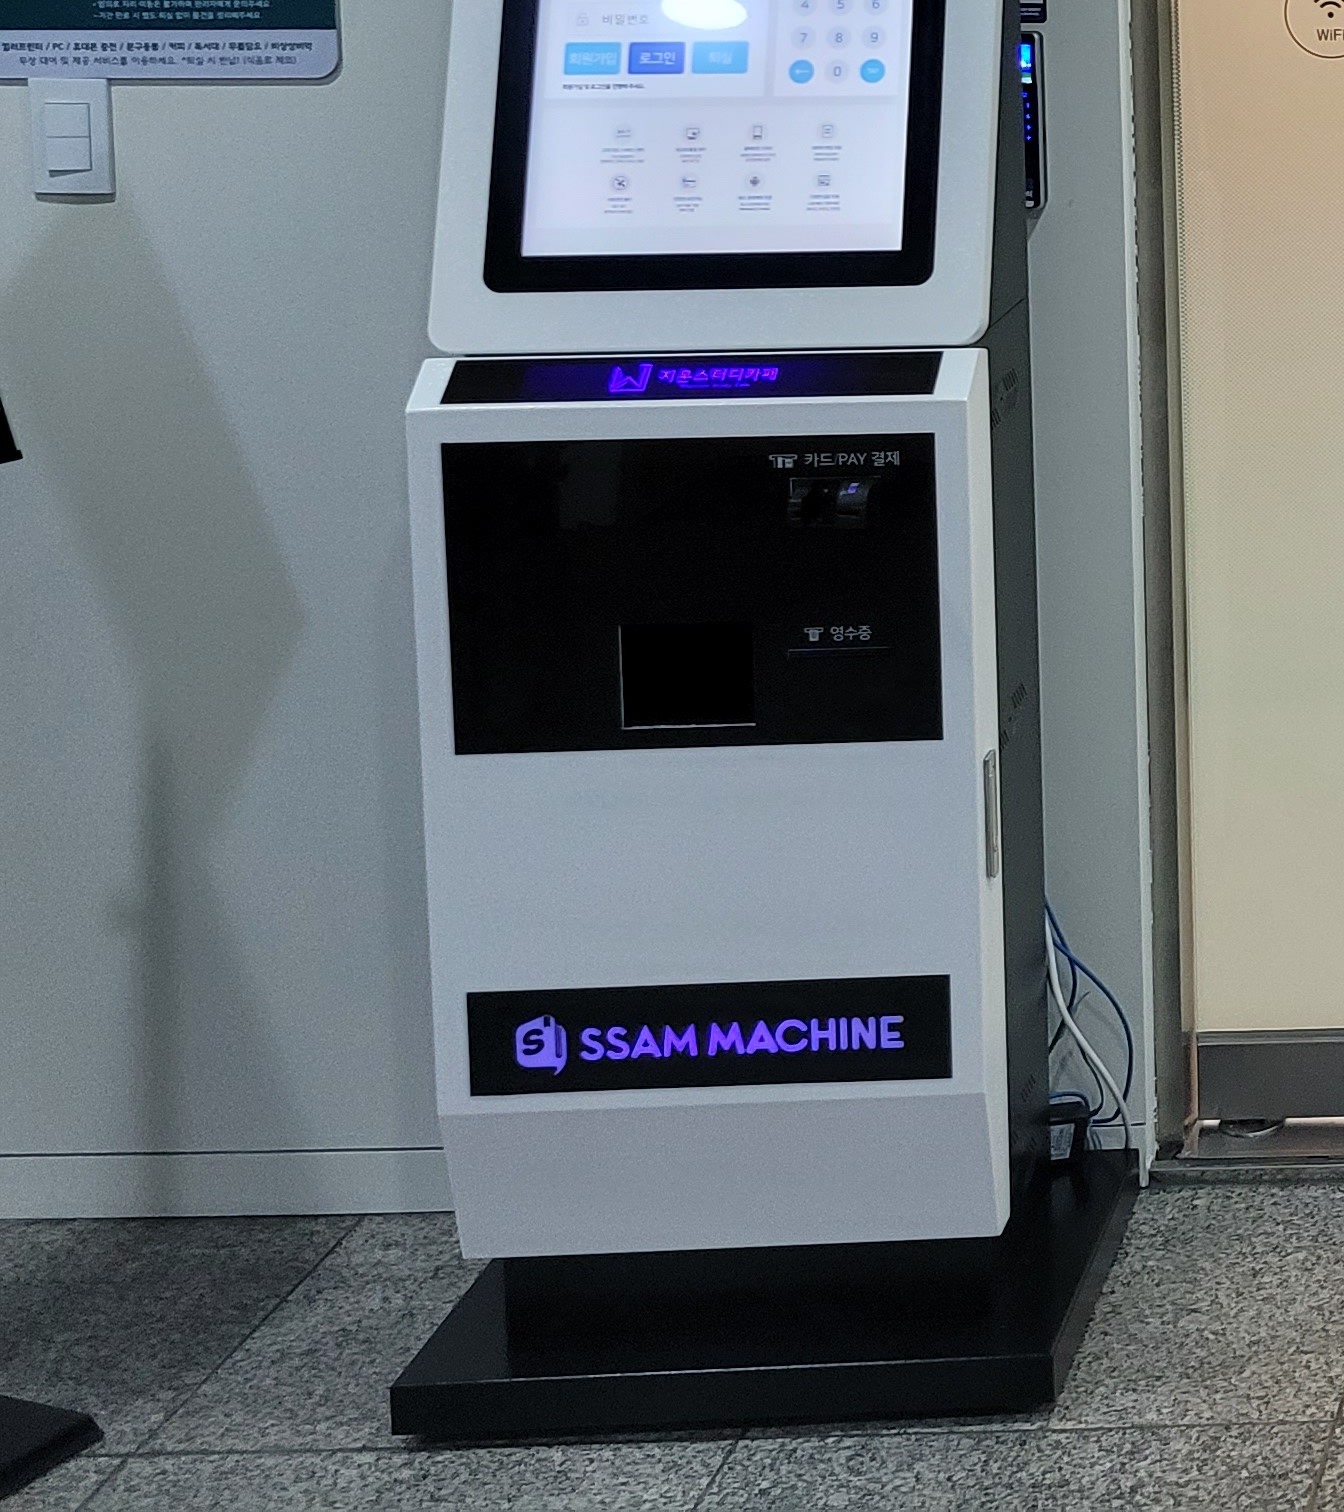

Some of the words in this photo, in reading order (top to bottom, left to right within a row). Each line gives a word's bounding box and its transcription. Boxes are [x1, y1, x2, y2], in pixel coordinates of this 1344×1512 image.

[602, 13, 649, 26] 비밀번호
[52, 43, 64, 51] PC
[639, 51, 676, 64] 로그인
[804, 451, 867, 467] 카드/PAY
[871, 450, 900, 467] 결제
[830, 625, 872, 642] 영수증
[580, 1025, 698, 1062] SSAM
[706, 1015, 905, 1058] MACHINE
